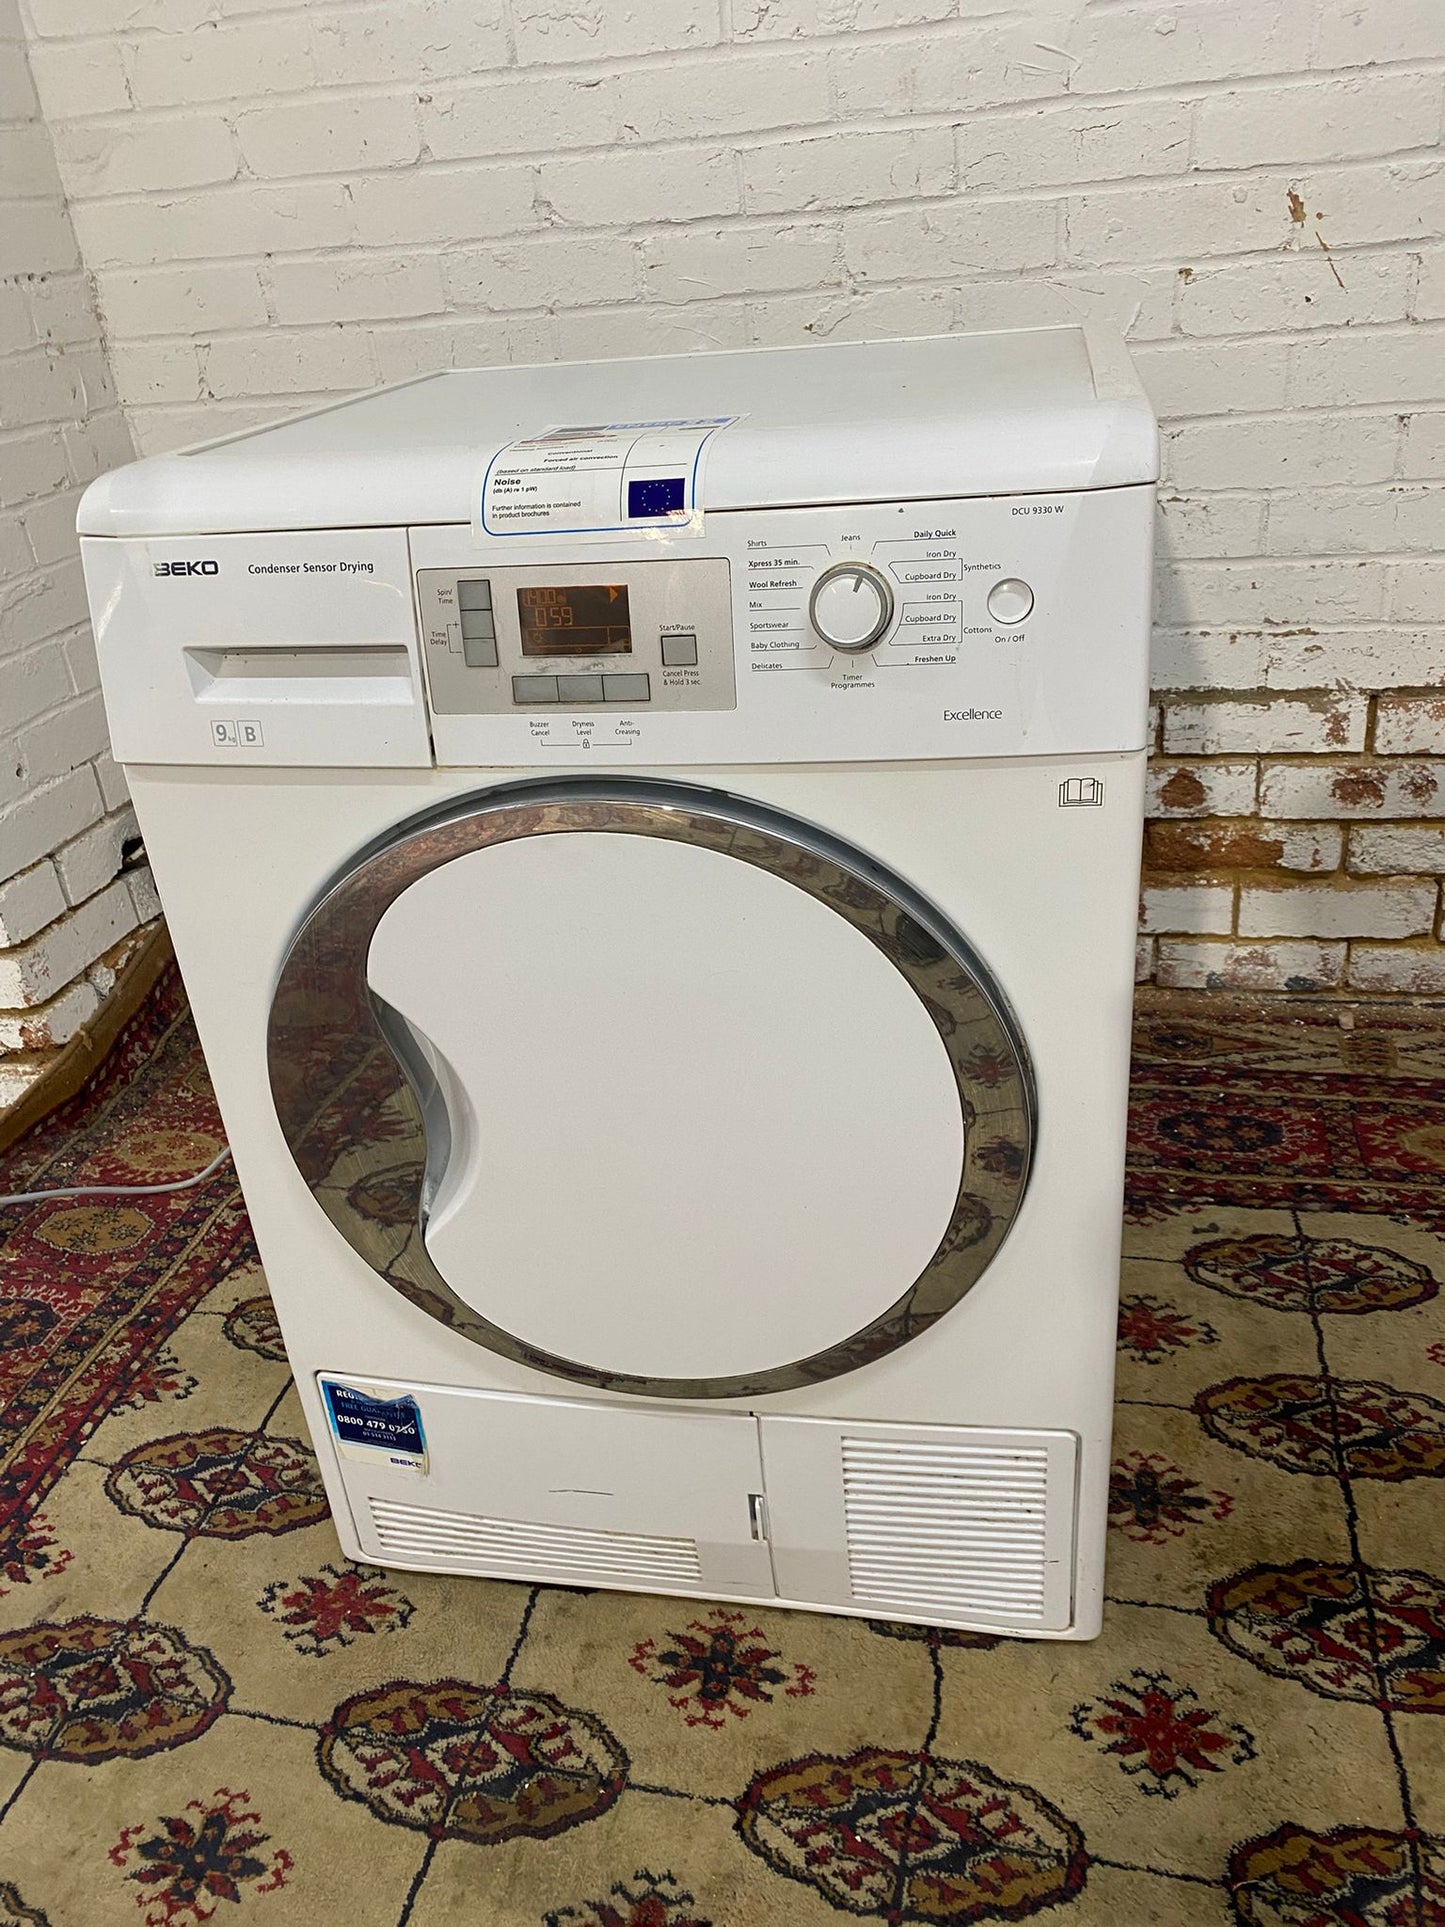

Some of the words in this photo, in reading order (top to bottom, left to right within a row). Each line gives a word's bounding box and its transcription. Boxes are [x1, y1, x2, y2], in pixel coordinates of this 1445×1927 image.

[494, 478, 521, 486] Noise
[514, 502, 546, 510] information
[1011, 506, 1031, 516] DCU
[1032, 505, 1053, 514] 9330
[1054, 505, 1064, 513] W
[499, 511, 521, 519] product
[841, 534, 861, 542] Jeans
[913, 530, 933, 540] Daily
[934, 528, 957, 538] Quick
[747, 539, 768, 547] Shirts
[926, 550, 942, 559] Iron
[943, 549, 957, 560] Dry
[748, 559, 773, 569] Xpress
[774, 558, 783, 567] 35
[963, 562, 1002, 572] Synthetics
[155, 561, 219, 576] BEKO
[248, 564, 300, 575] Condenser
[303, 562, 337, 573] Sensor
[339, 561, 375, 574] Drying
[904, 572, 942, 582] Cupboard
[943, 571, 957, 582] Dry
[749, 581, 769, 589] Wool
[769, 578, 797, 588] Refresh
[437, 588, 453, 597] Spin/
[926, 593, 942, 601] Iron
[943, 592, 957, 602] Dry
[438, 597, 453, 605] Time
[905, 614, 942, 624] Cupboard
[943, 613, 957, 624] Dry
[659, 624, 696, 632] Start/Pause
[750, 622, 789, 630] Sportswear
[963, 626, 993, 634] Cottons
[431, 631, 447, 639] Time
[943, 634, 957, 644] Dry
[994, 636, 1007, 644] On
[1012, 634, 1025, 643] Off
[430, 638, 448, 647] Delay
[750, 642, 768, 651] Baby
[769, 641, 800, 650] Clothing
[914, 655, 944, 664] Freshen
[944, 654, 957, 664] Up
[751, 662, 783, 670] Delicates
[662, 670, 683, 678] Cancel
[669, 678, 684, 686] Hold
[686, 678, 690, 686] 3
[830, 682, 875, 690] Programmes
[943, 708, 1003, 721] Excellence
[571, 721, 595, 729] Dryness
[245, 726, 256, 742] B
[576, 728, 592, 736] Level
[615, 727, 640, 736] Creasing
[337, 1414, 364, 1426] 0800
[366, 1420, 386, 1430] 479
